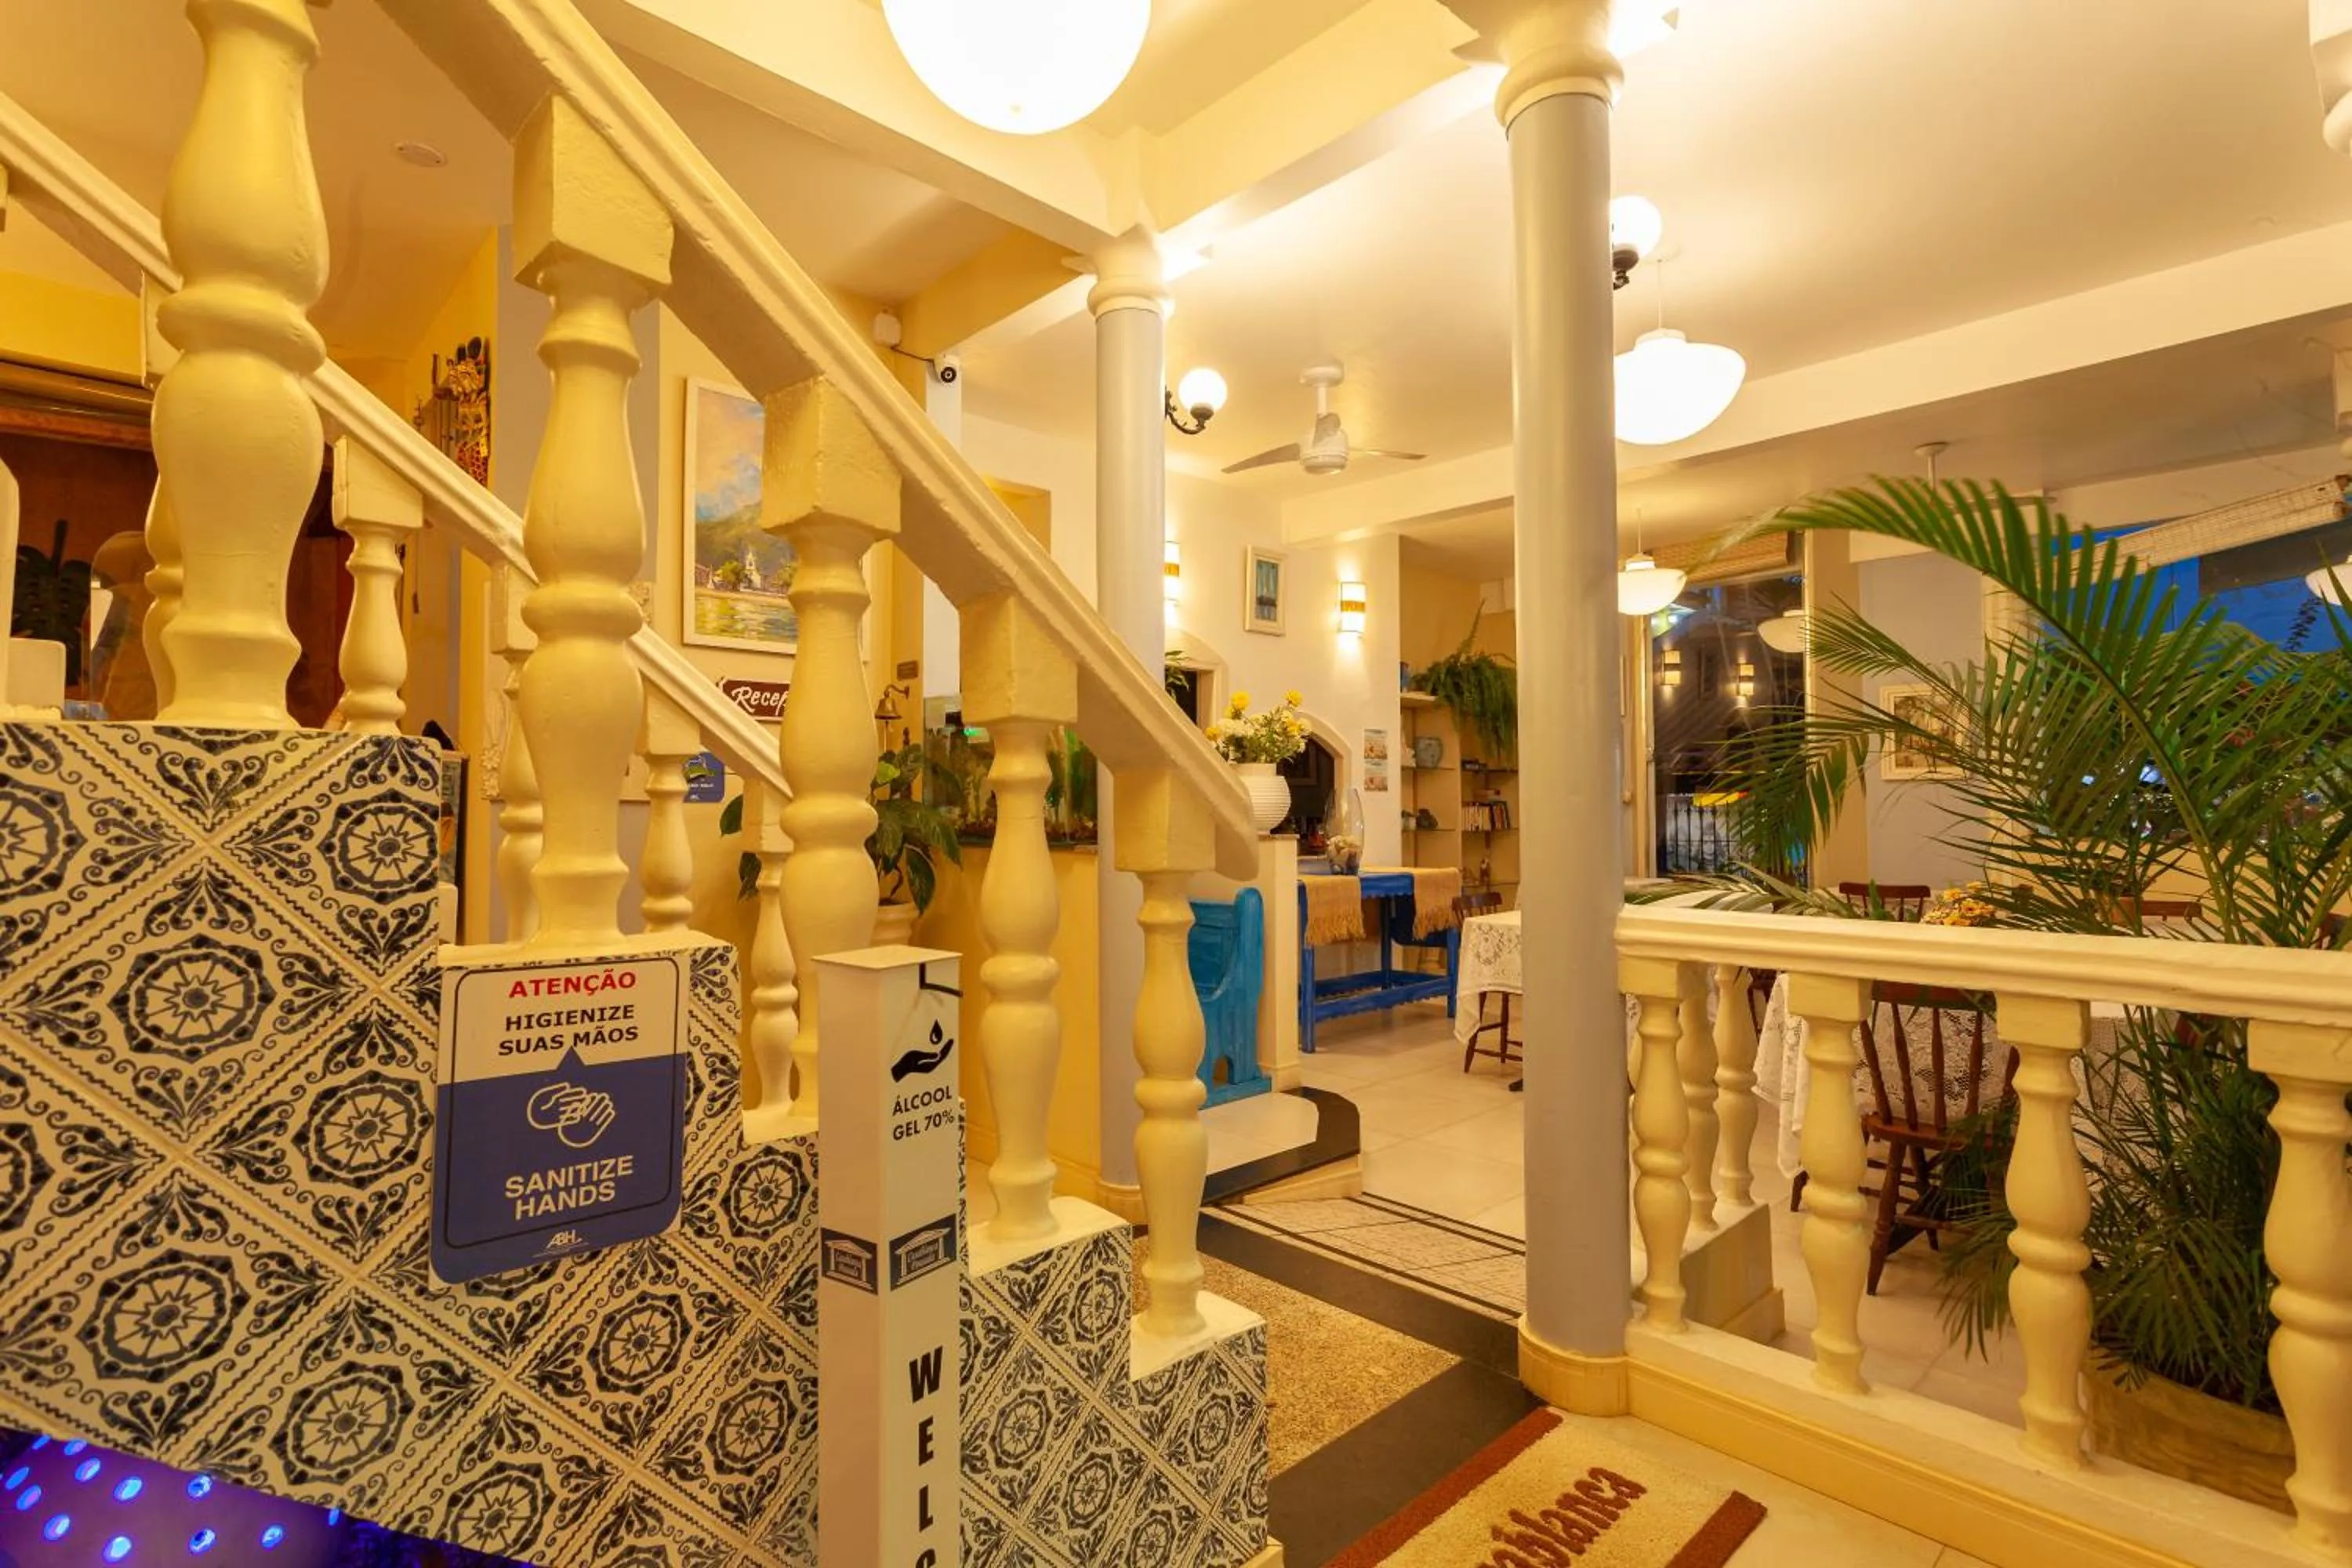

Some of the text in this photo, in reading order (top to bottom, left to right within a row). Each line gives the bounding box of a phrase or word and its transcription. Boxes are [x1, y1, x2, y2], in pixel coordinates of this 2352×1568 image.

[508, 968, 637, 998] ATENÇÃO
[505, 1004, 635, 1032] HIGIENIZE
[498, 1025, 638, 1056] SUAS MÃOS
[892, 1085, 953, 1116] ÁLCOOL
[892, 1109, 955, 1141] GEL 70%
[504, 1155, 633, 1199] SANITIZE
[515, 1181, 616, 1221] HANDS
[1477, 1467, 1647, 1568] blanca
